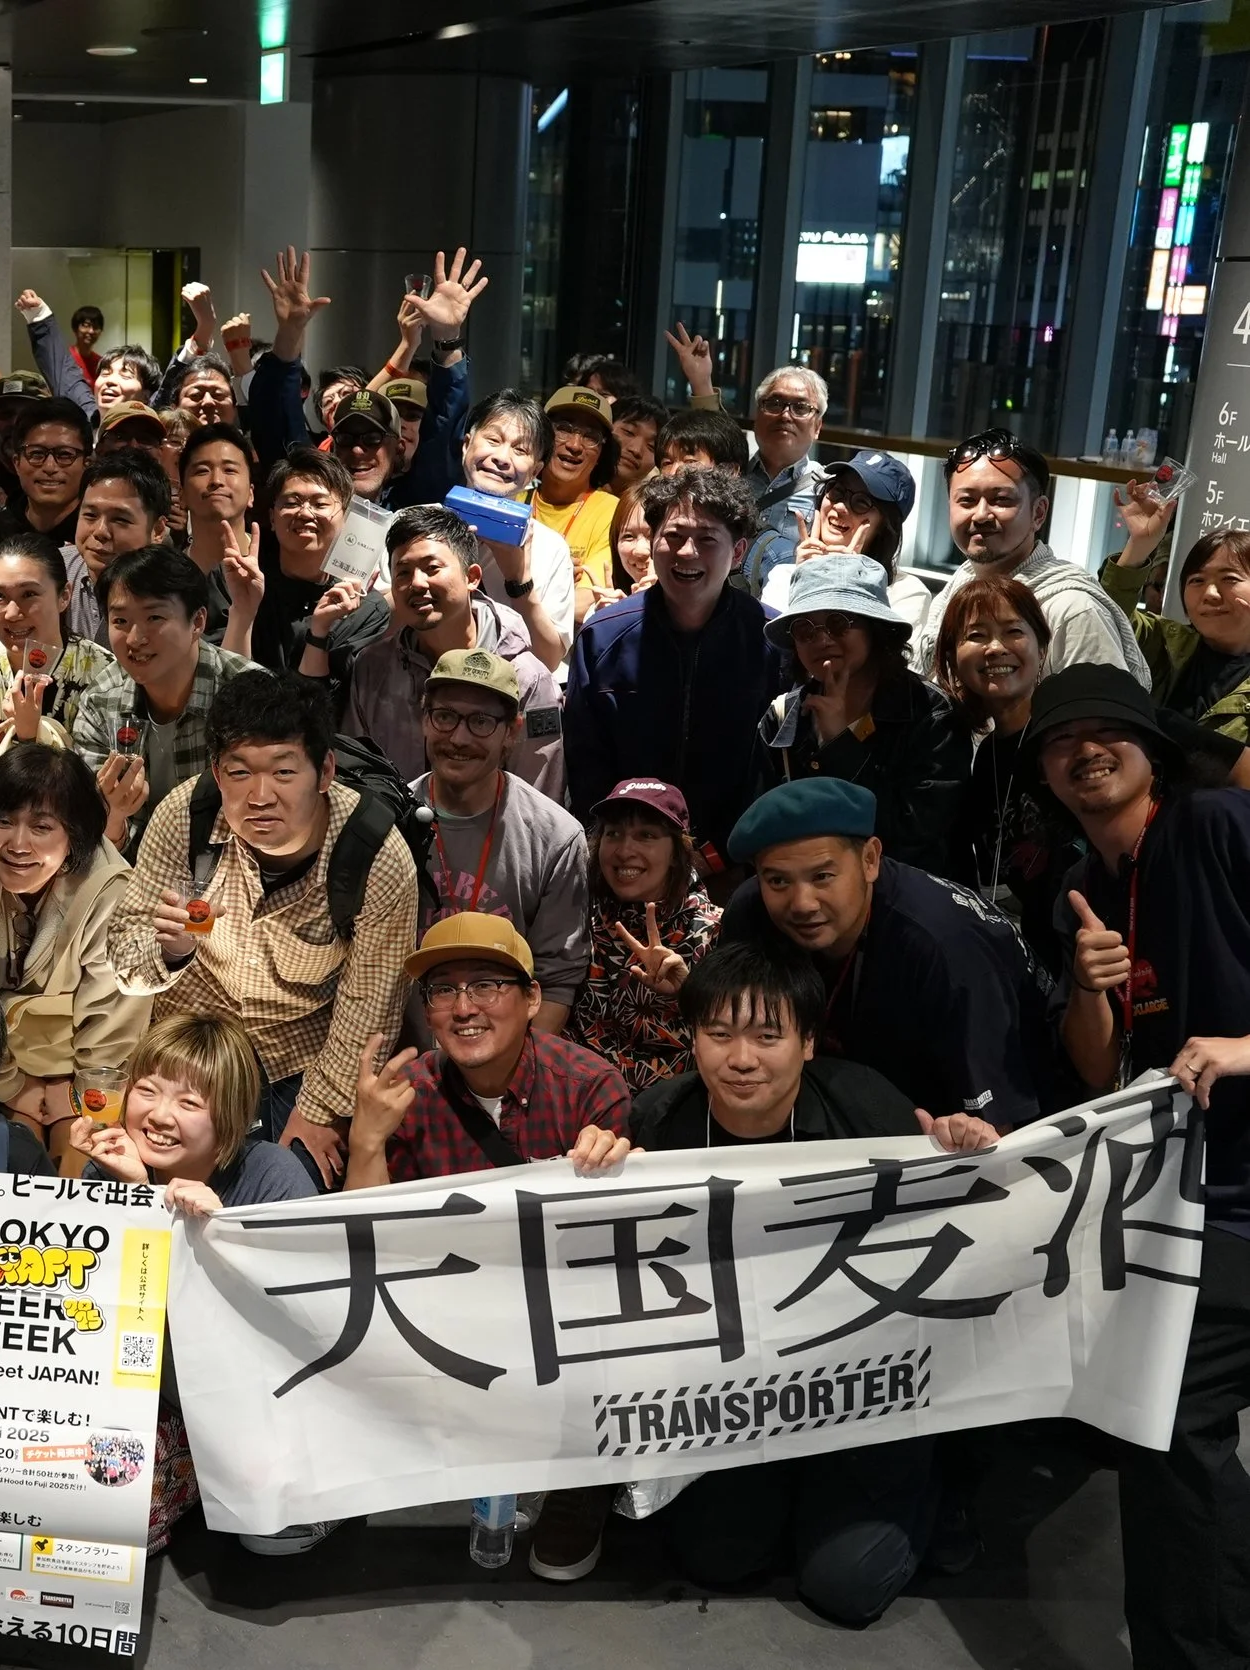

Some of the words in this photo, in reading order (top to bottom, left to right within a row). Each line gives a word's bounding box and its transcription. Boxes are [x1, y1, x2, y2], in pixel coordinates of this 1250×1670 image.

[822, 231, 868, 243] PLAZA
[1218, 402, 1238, 426] 6F
[1212, 452, 1227, 464] Hall
[1206, 481, 1225, 505] 5F
[1201, 510, 1250, 532] ホワイエ
[27, 1365, 100, 1386] JAPAN!
[610, 1362, 916, 1445] TRANSPORTER
[7, 1427, 50, 1443] 2025
[56, 1543, 119, 1557] スタンプラリー
